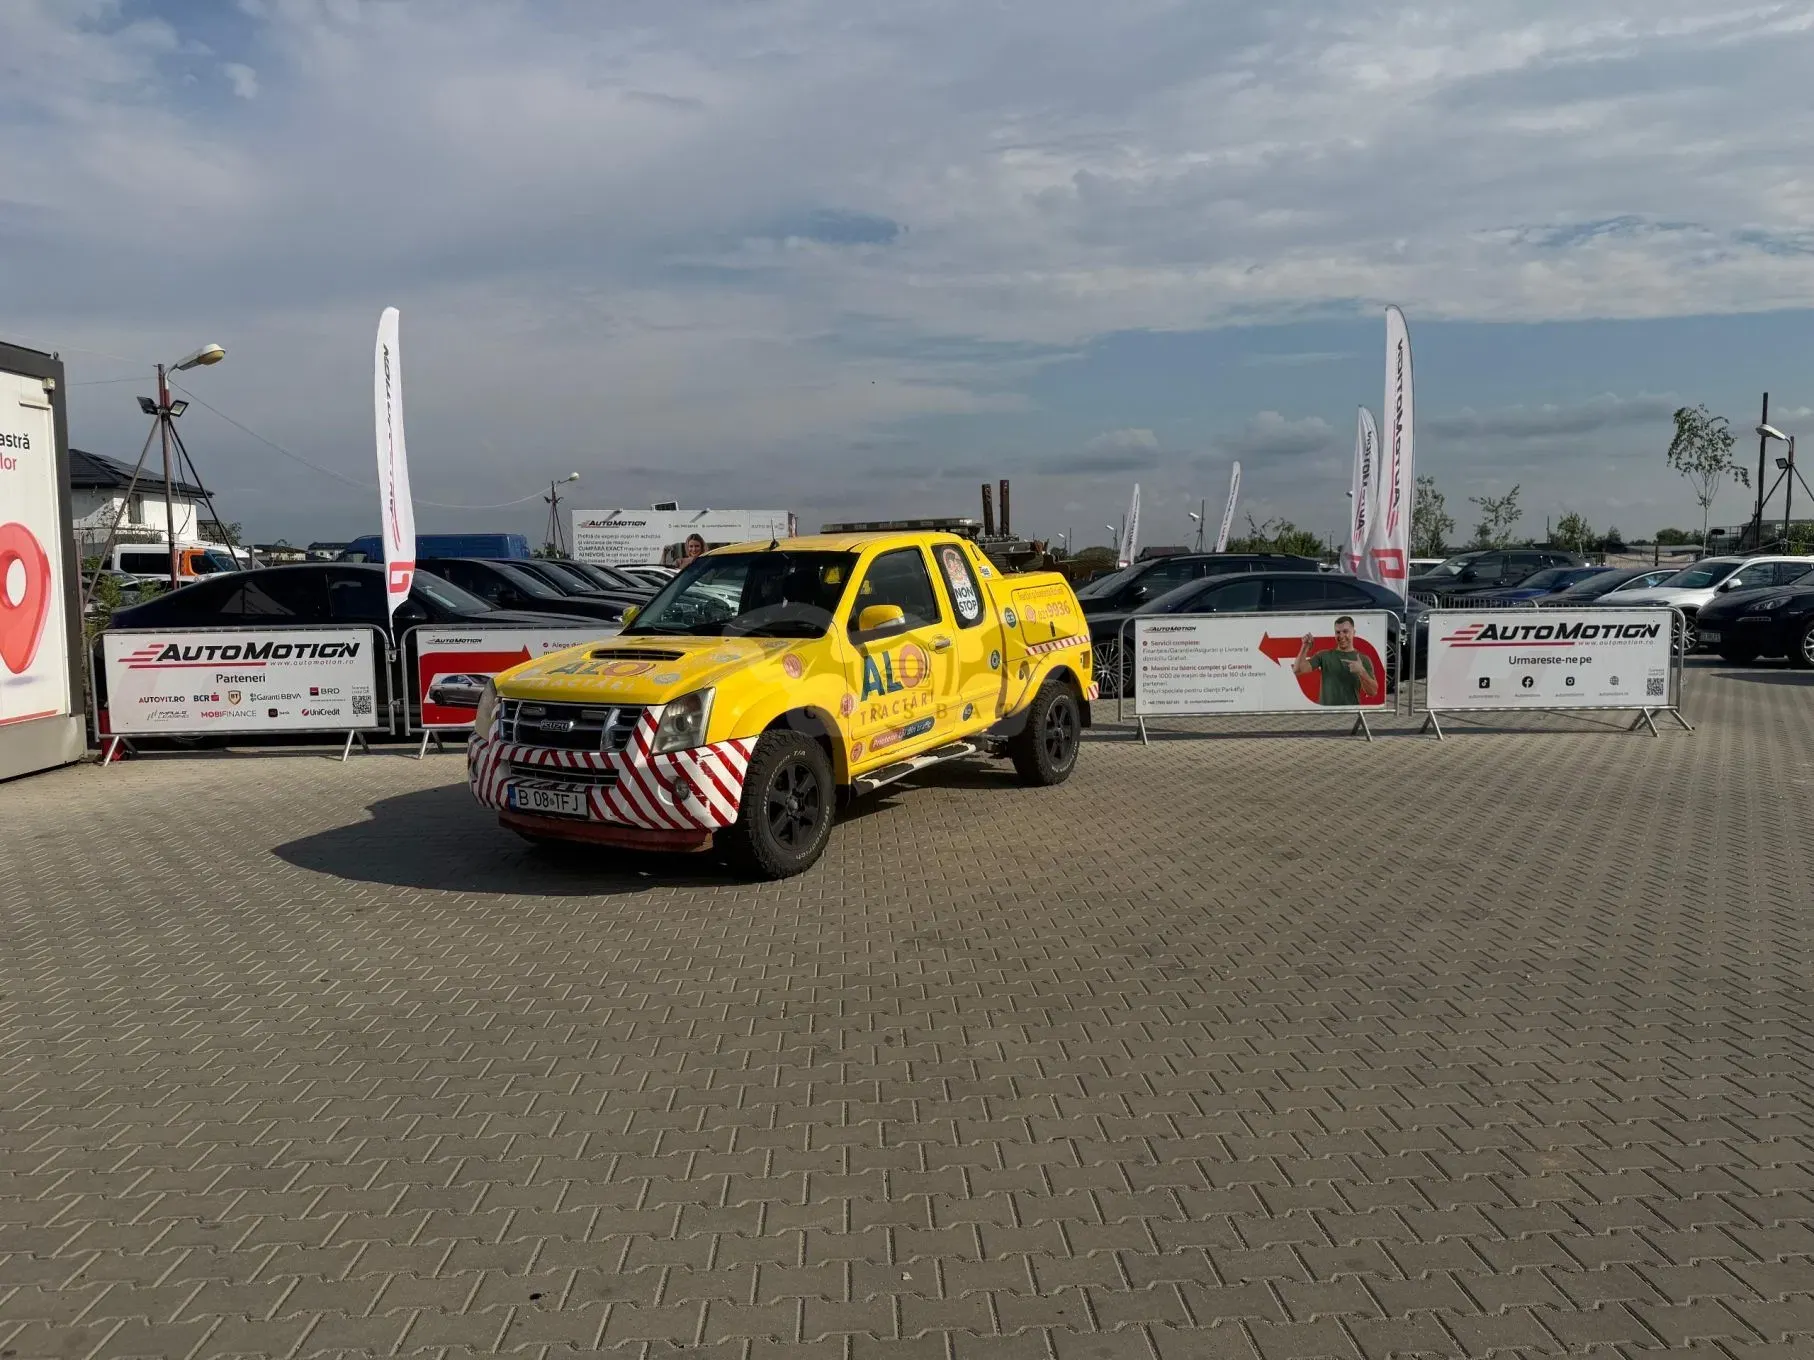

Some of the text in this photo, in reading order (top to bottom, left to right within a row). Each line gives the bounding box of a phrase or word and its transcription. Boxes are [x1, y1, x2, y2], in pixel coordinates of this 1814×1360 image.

[0, 452, 17, 470] lor
[954, 586, 974, 598] NON
[959, 600, 977, 612] STOP
[1475, 623, 1661, 640] AUTOMOTION
[156, 642, 360, 661] AUTOMOTION
[1508, 655, 1593, 666] Urmareste-ne pe
[215, 673, 266, 683] Parteneri
[860, 643, 928, 702] ALO
[139, 695, 185, 703] AUTOVIT.RO
[193, 694, 210, 702] BCR
[281, 692, 302, 700] BBVA
[200, 710, 257, 718] MOBIFINANCE
[309, 708, 340, 716] UniCredit
[541, 720, 570, 732] ISUZU
[518, 789, 579, 812] B 08 TFJ
